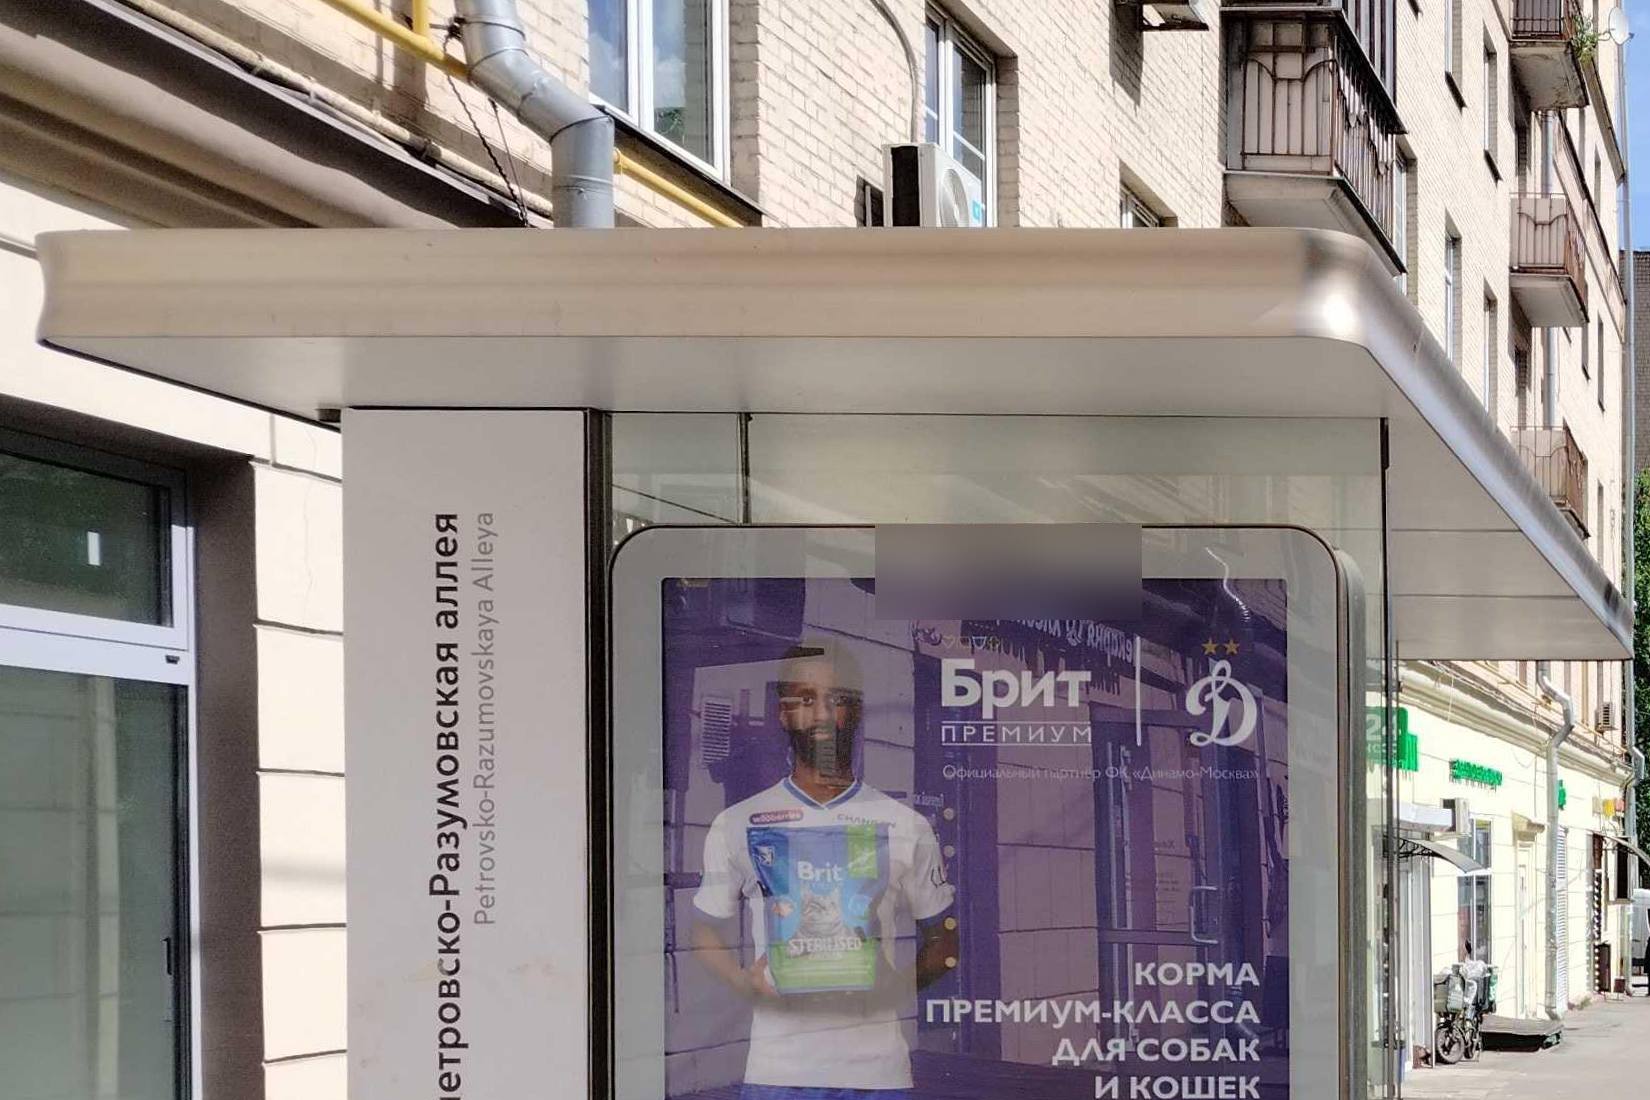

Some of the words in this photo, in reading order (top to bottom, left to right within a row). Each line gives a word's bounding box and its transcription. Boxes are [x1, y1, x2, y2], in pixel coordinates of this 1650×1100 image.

[470, 512, 498, 592] Alleya
[435, 513, 459, 629] аллея
[940, 658, 1092, 718] Брит
[941, 725, 1092, 743] ПРЕМИУМ
[470, 599, 499, 925] Petrovsko-Razumovskaya
[942, 763, 1040, 783] Официальный
[1104, 764, 1128, 783] ФК
[797, 861, 844, 882] Brit
[1134, 962, 1261, 987] КОРМА
[926, 999, 1261, 1029] ПРЕМИУМ-КЛАССА
[1051, 1038, 1126, 1066] ДЛЯ
[1136, 1037, 1261, 1062] СОБАК
[1095, 1076, 1119, 1099] И
[1130, 1076, 1261, 1099] КОШЕК
